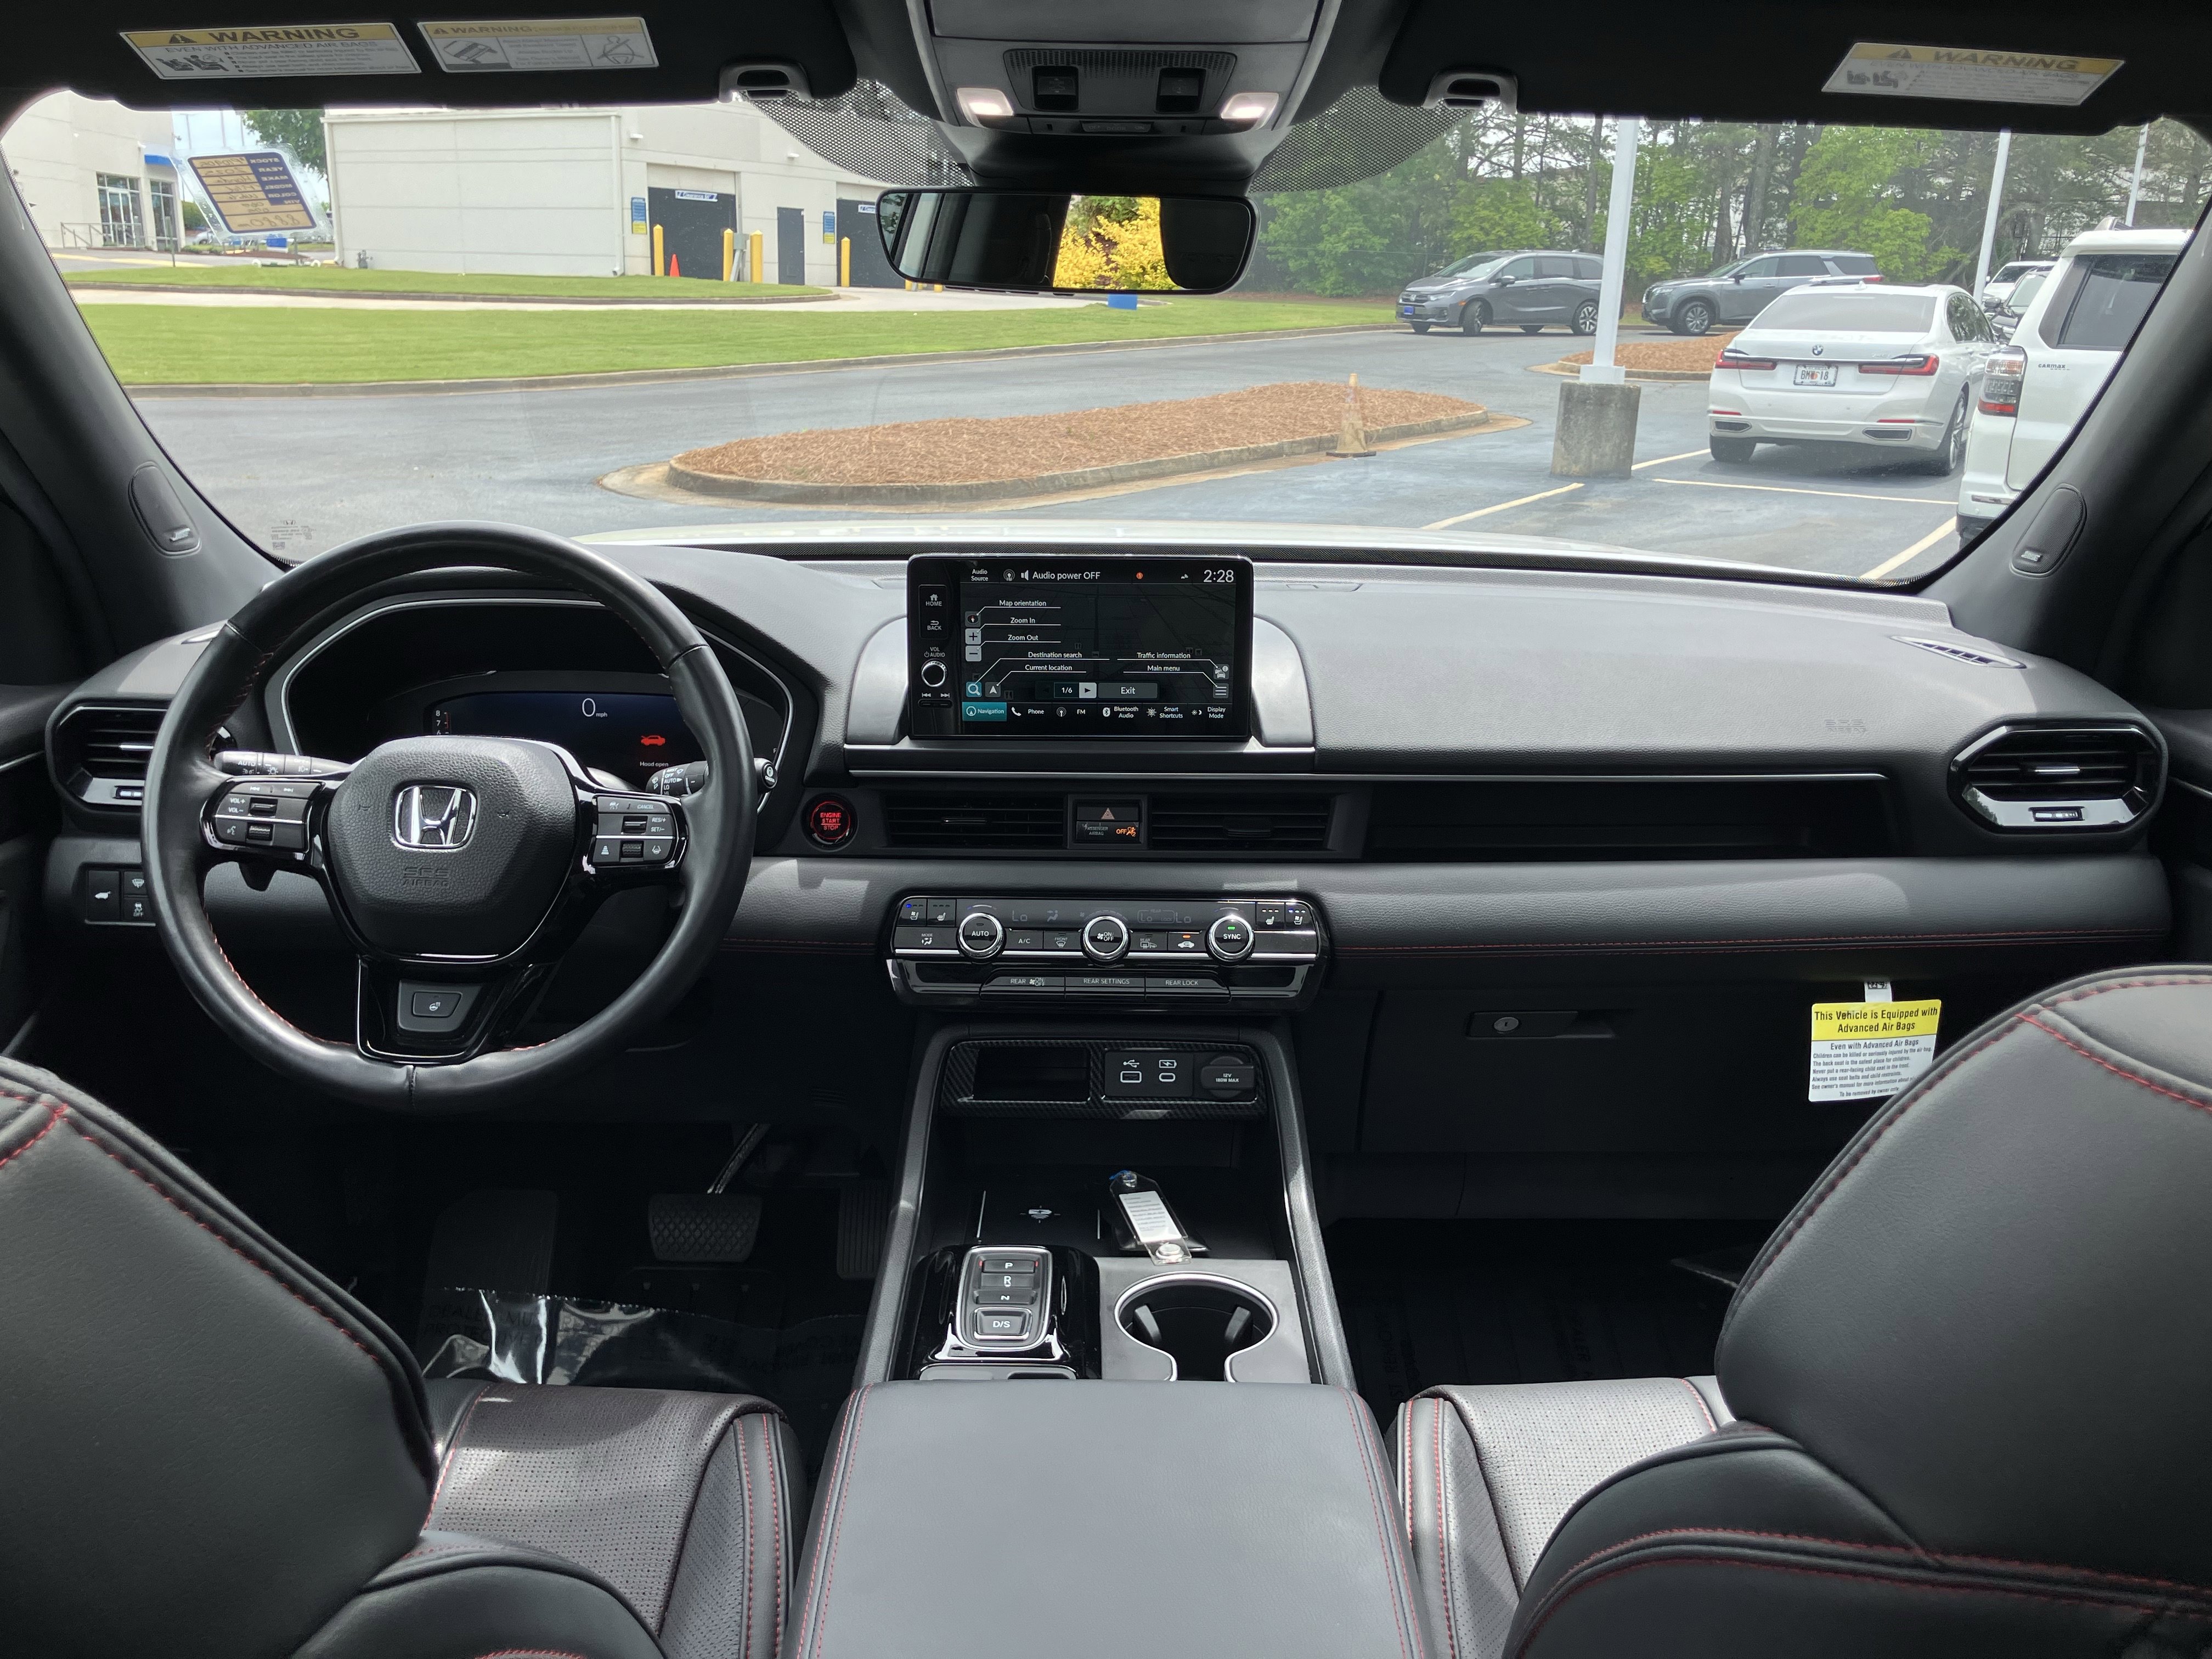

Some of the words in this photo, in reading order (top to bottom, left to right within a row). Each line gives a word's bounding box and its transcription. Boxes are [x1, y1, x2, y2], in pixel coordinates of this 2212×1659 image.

[208, 27, 360, 42] WARNING
[452, 25, 534, 34] WARNING
[1933, 50, 2081, 71] WARNING
[1057, 573, 1082, 582] power
[1204, 570, 1234, 583] 2:28
[582, 698, 596, 716] 0
[404, 867, 450, 877] SRS
[402, 879, 452, 887] AIRBAG
[1012, 910, 1028, 922] Lo
[1141, 912, 1153, 922] Lo
[1176, 912, 1192, 923] Lo
[1815, 1011, 1833, 1020] This
[1836, 1010, 1867, 1020] Vehicle
[1871, 1010, 1878, 1019] is
[1881, 1008, 1919, 1020] Equipped
[1921, 1007, 1938, 1017] with
[1838, 1023, 1879, 1032] Advanced
[1882, 1023, 1894, 1031] Air
[1896, 1022, 1915, 1031] Bags
[1004, 1276, 1012, 1285] R
